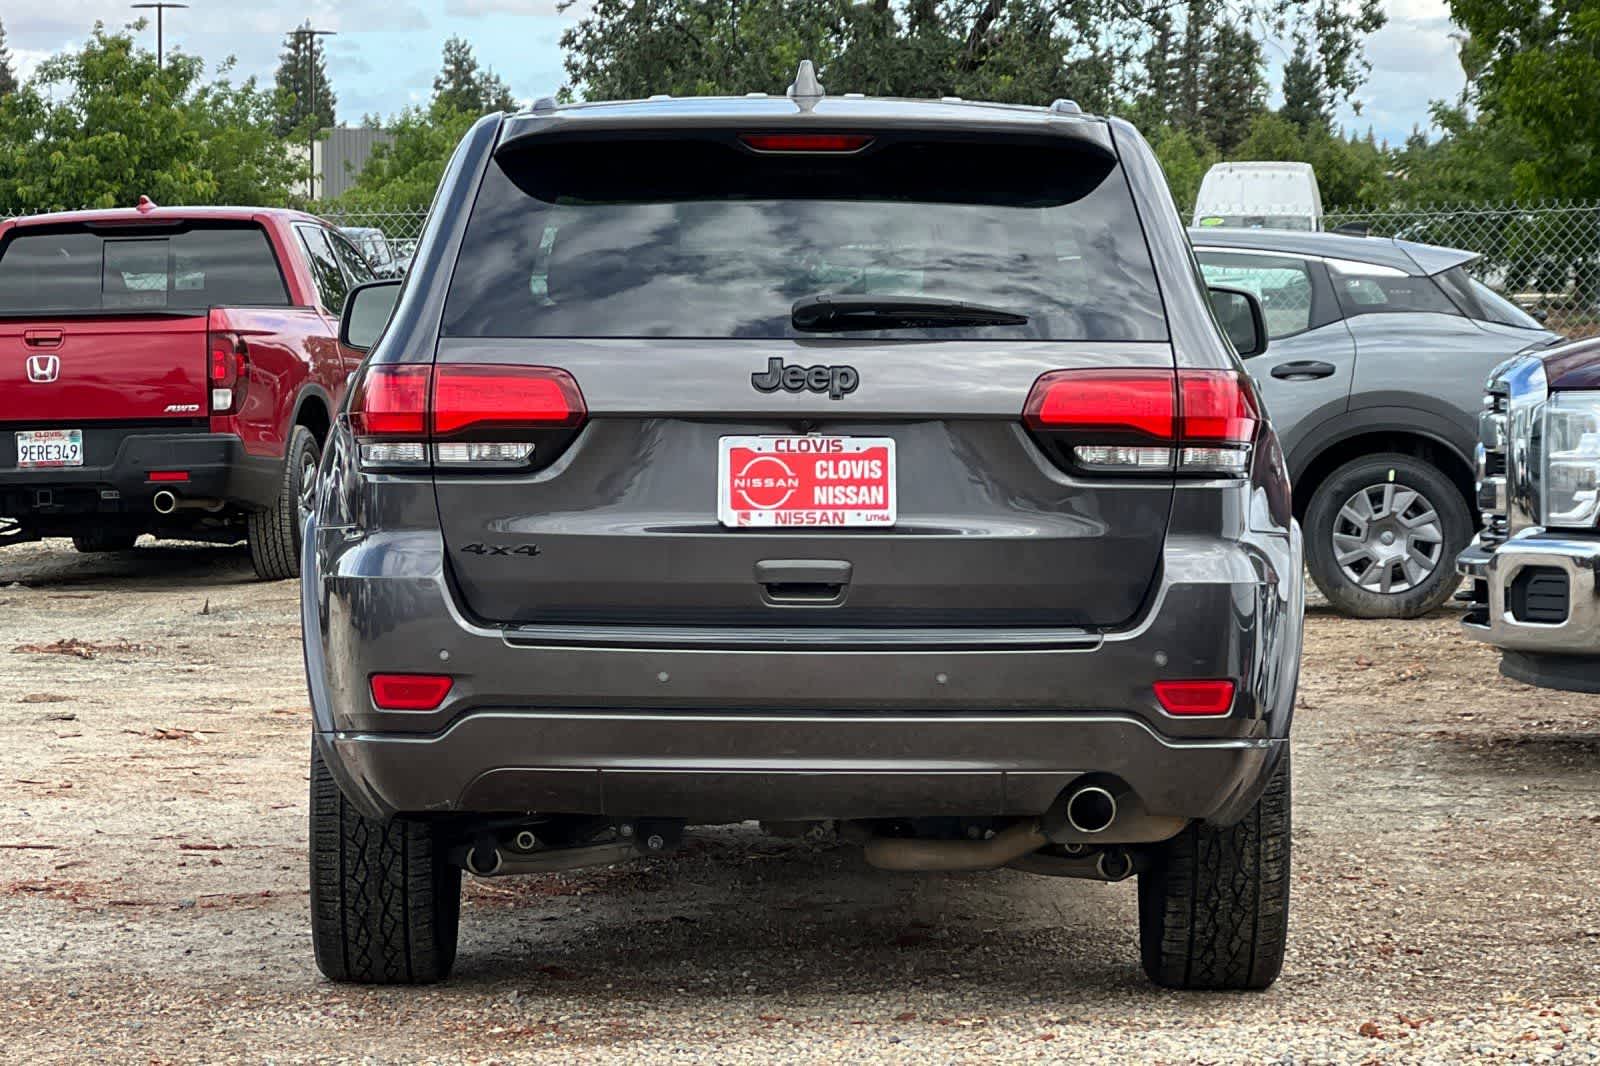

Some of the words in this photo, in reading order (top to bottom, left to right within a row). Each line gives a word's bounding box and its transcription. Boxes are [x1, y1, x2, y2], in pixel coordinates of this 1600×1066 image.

[751, 357, 859, 400] Jeep
[163, 404, 199, 412] AWD
[20, 444, 78, 461] 9ERE349
[775, 439, 844, 453] CLOVIS
[815, 460, 882, 480] CLOVIS
[734, 478, 799, 488] NISSAN
[814, 485, 884, 505] NISSAN
[774, 511, 845, 525] NISSAN
[460, 543, 541, 556] 4x4
